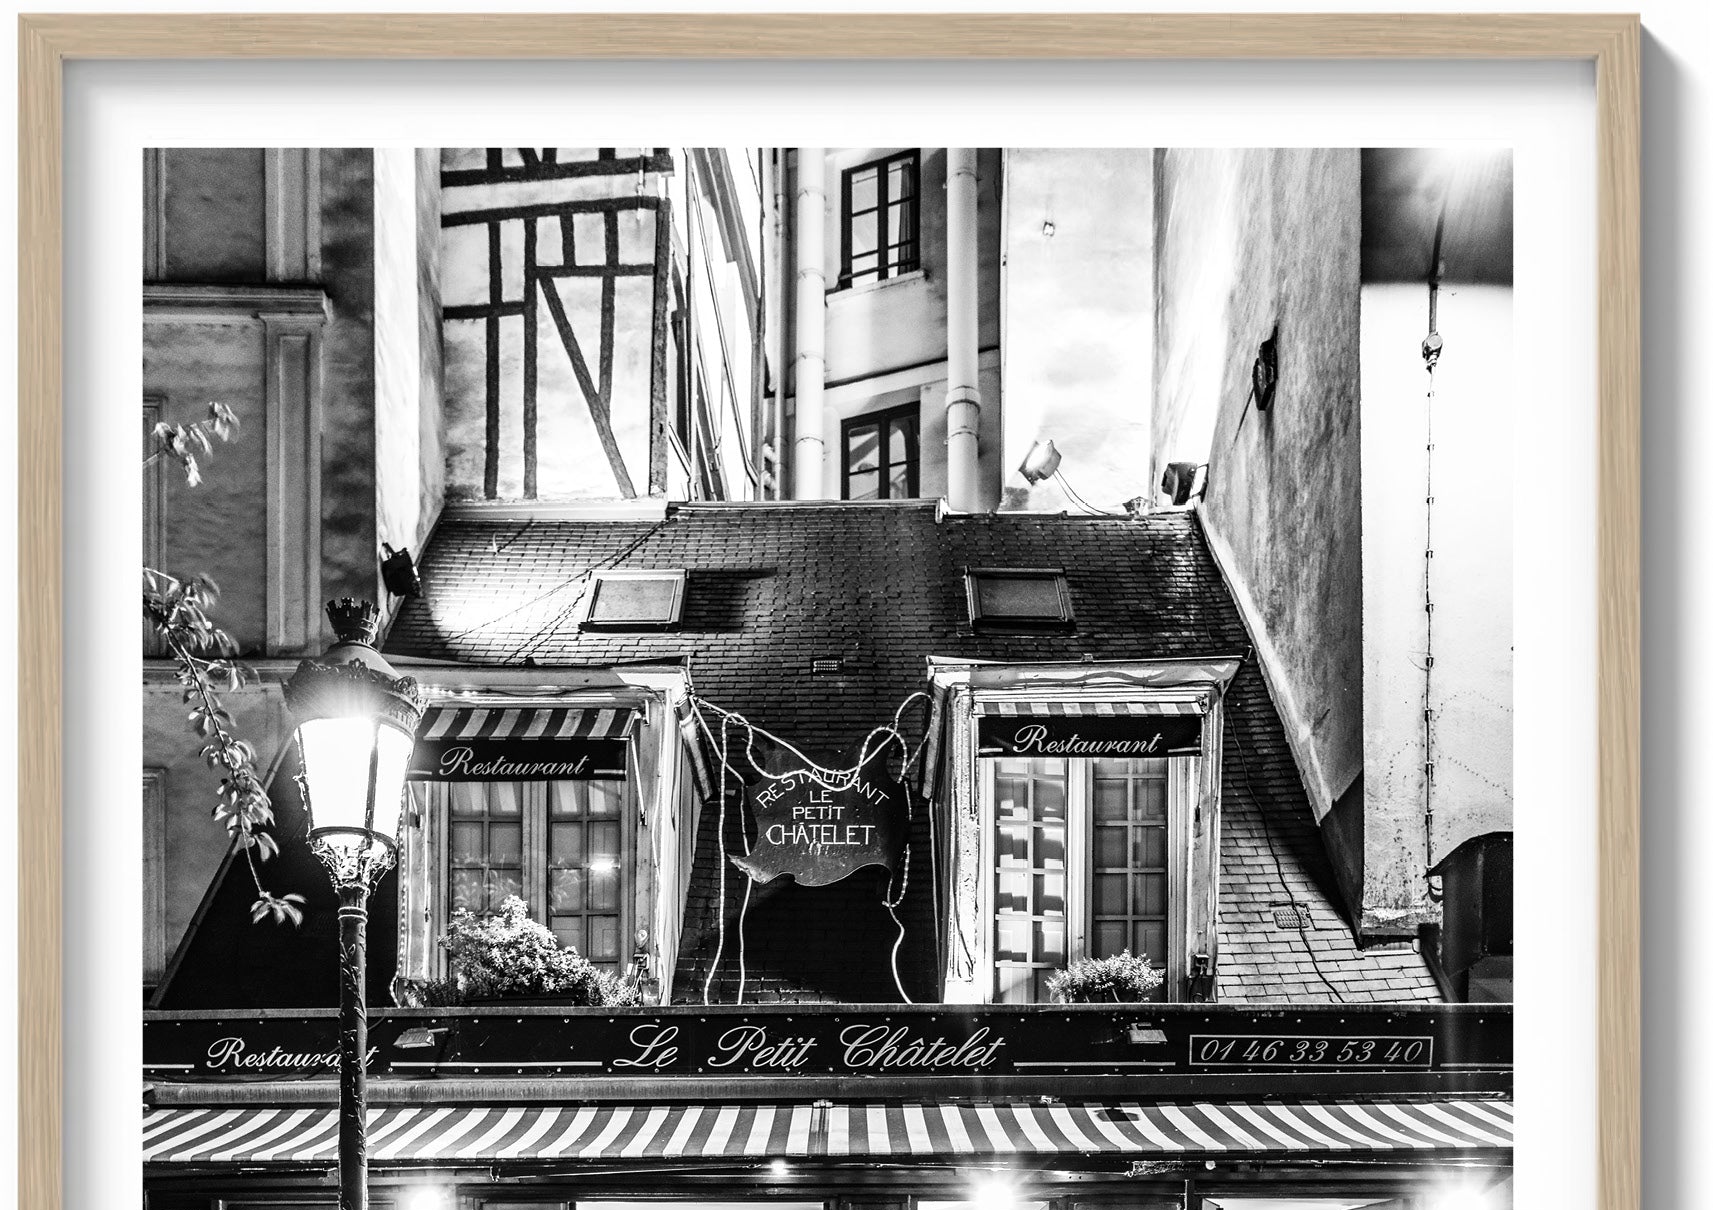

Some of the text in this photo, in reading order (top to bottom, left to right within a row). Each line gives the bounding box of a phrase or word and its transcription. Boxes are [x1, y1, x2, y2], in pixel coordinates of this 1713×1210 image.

[1012, 724, 1163, 753] Restaurant
[438, 746, 590, 776] Restaurant
[755, 767, 890, 809] RESTAURANT
[809, 790, 833, 803] LE
[792, 805, 846, 820] PETIT
[206, 1037, 380, 1068] Restaurat
[613, 1024, 1007, 1068] Le Petit Châtelet
[1200, 1039, 1423, 1062] 01 46 33 53 40
